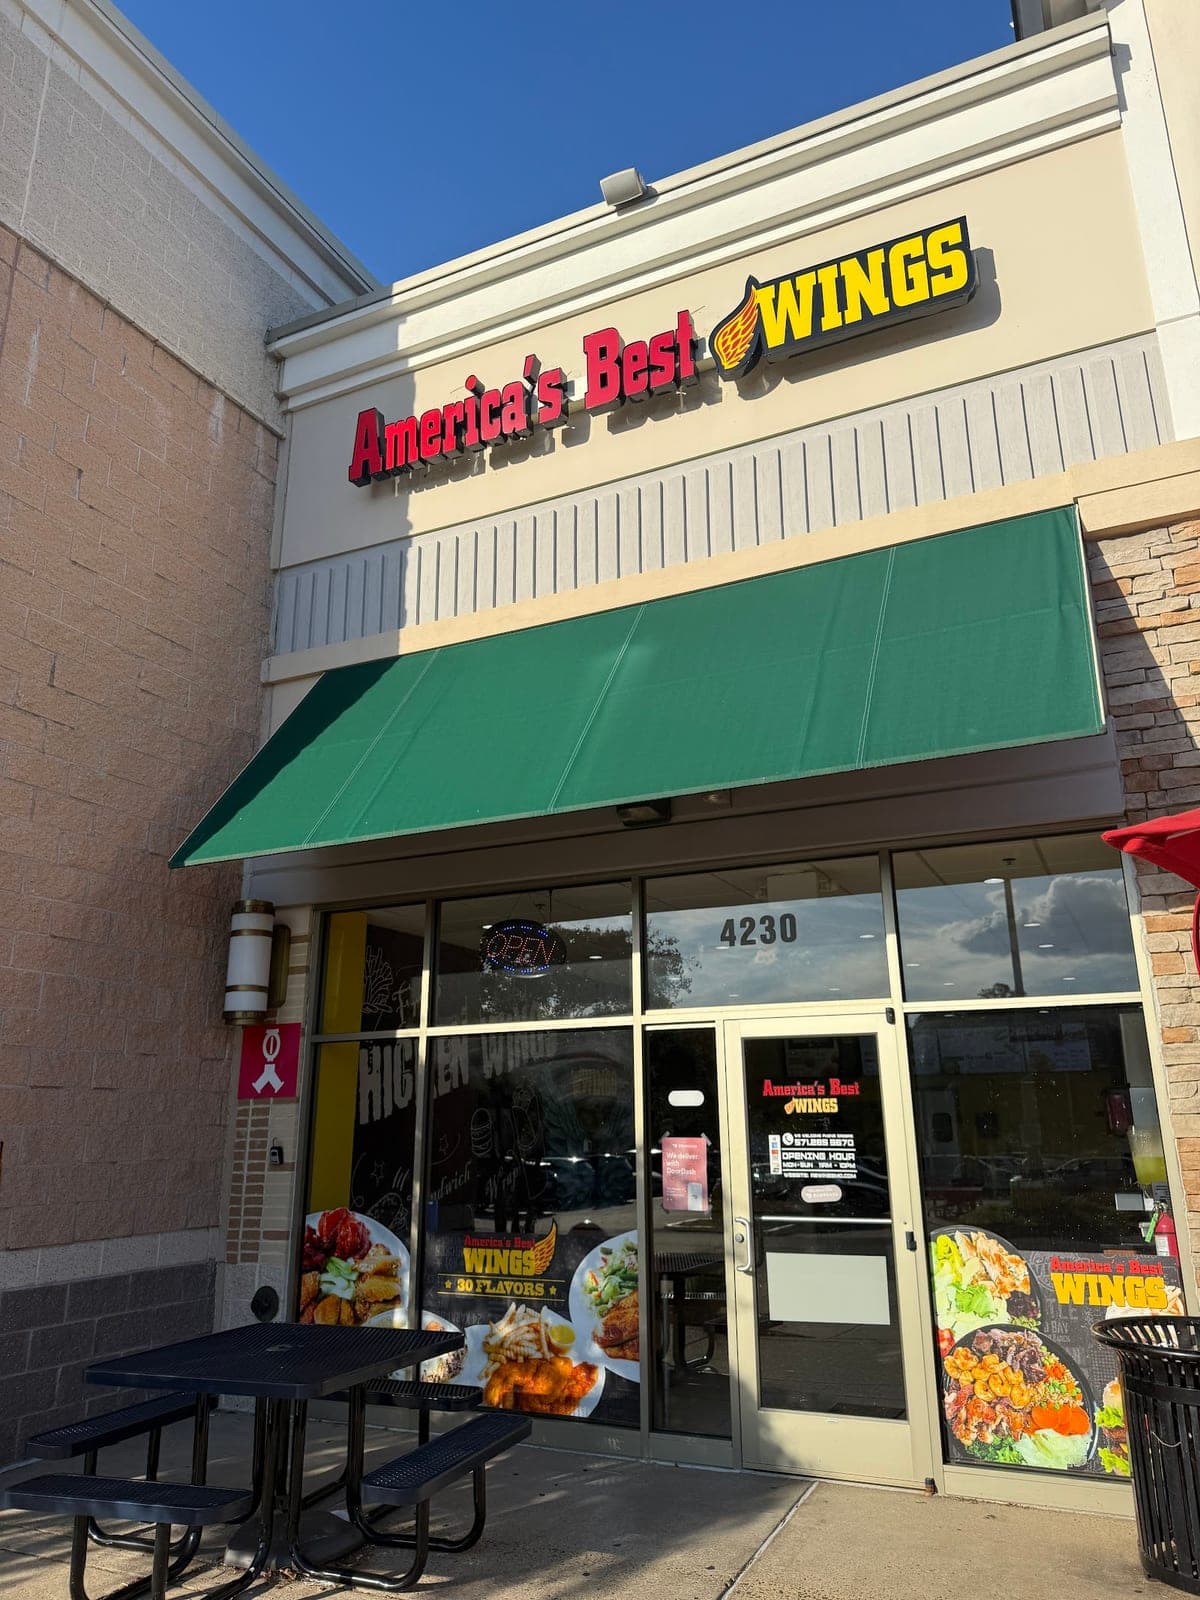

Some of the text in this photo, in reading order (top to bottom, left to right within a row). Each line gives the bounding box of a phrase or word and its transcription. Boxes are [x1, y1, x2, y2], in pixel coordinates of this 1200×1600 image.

[755, 226, 968, 348] WINGS
[348, 309, 698, 486] America's Best
[719, 912, 798, 947] 4230
[485, 930, 557, 964] OPEN
[763, 1078, 860, 1096] America's Best
[795, 1098, 838, 1113] WINGS
[782, 1151, 856, 1161] OPENING HOUR
[666, 1167, 696, 1176] DoorDash
[463, 1247, 536, 1276] WINGS
[1051, 1256, 1164, 1276] America's Best
[457, 1278, 545, 1297] 30 FLAVORS
[1050, 1272, 1168, 1310] WINGS
